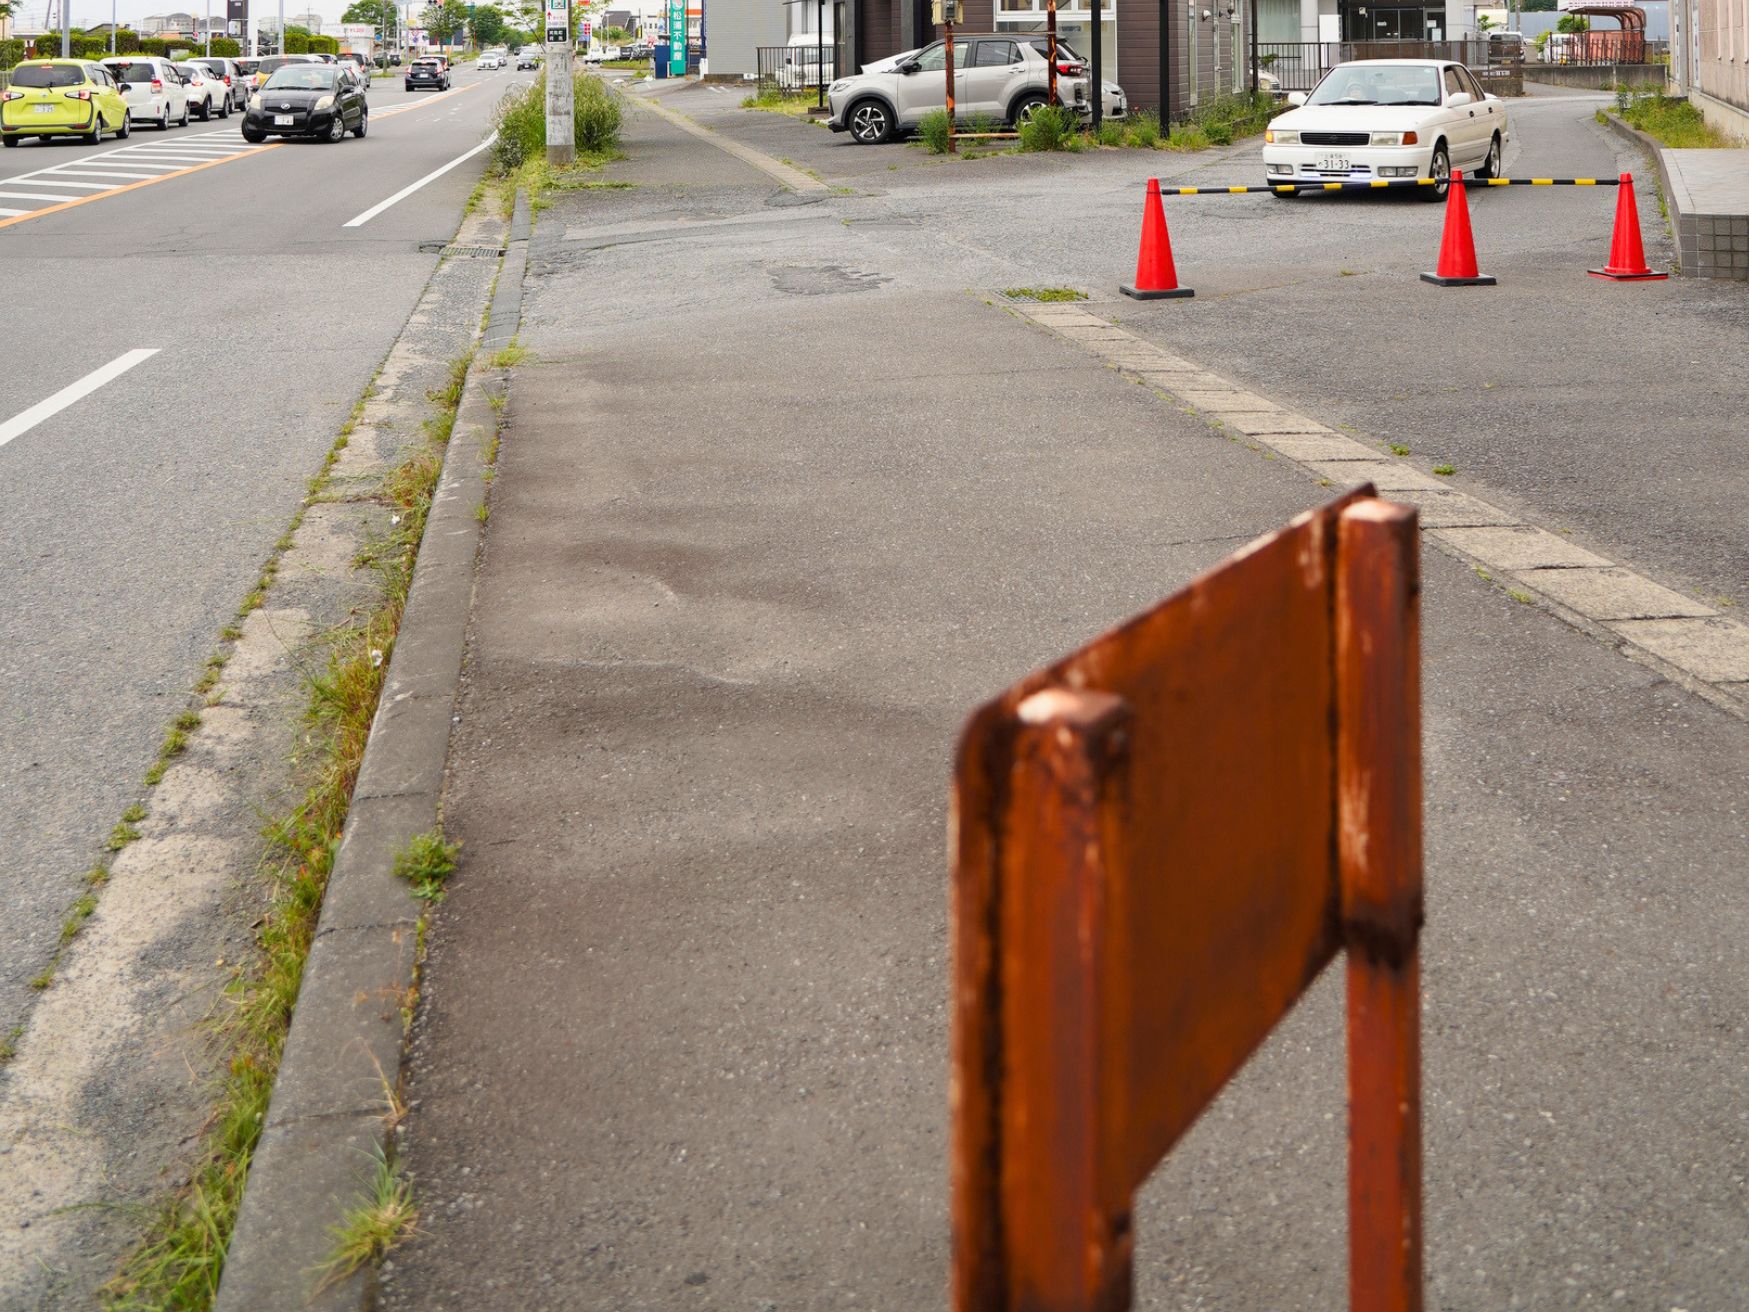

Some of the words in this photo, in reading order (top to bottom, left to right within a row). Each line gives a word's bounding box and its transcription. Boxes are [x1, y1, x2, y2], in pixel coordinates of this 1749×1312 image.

[673, 11, 682, 61] 松浦不動産
